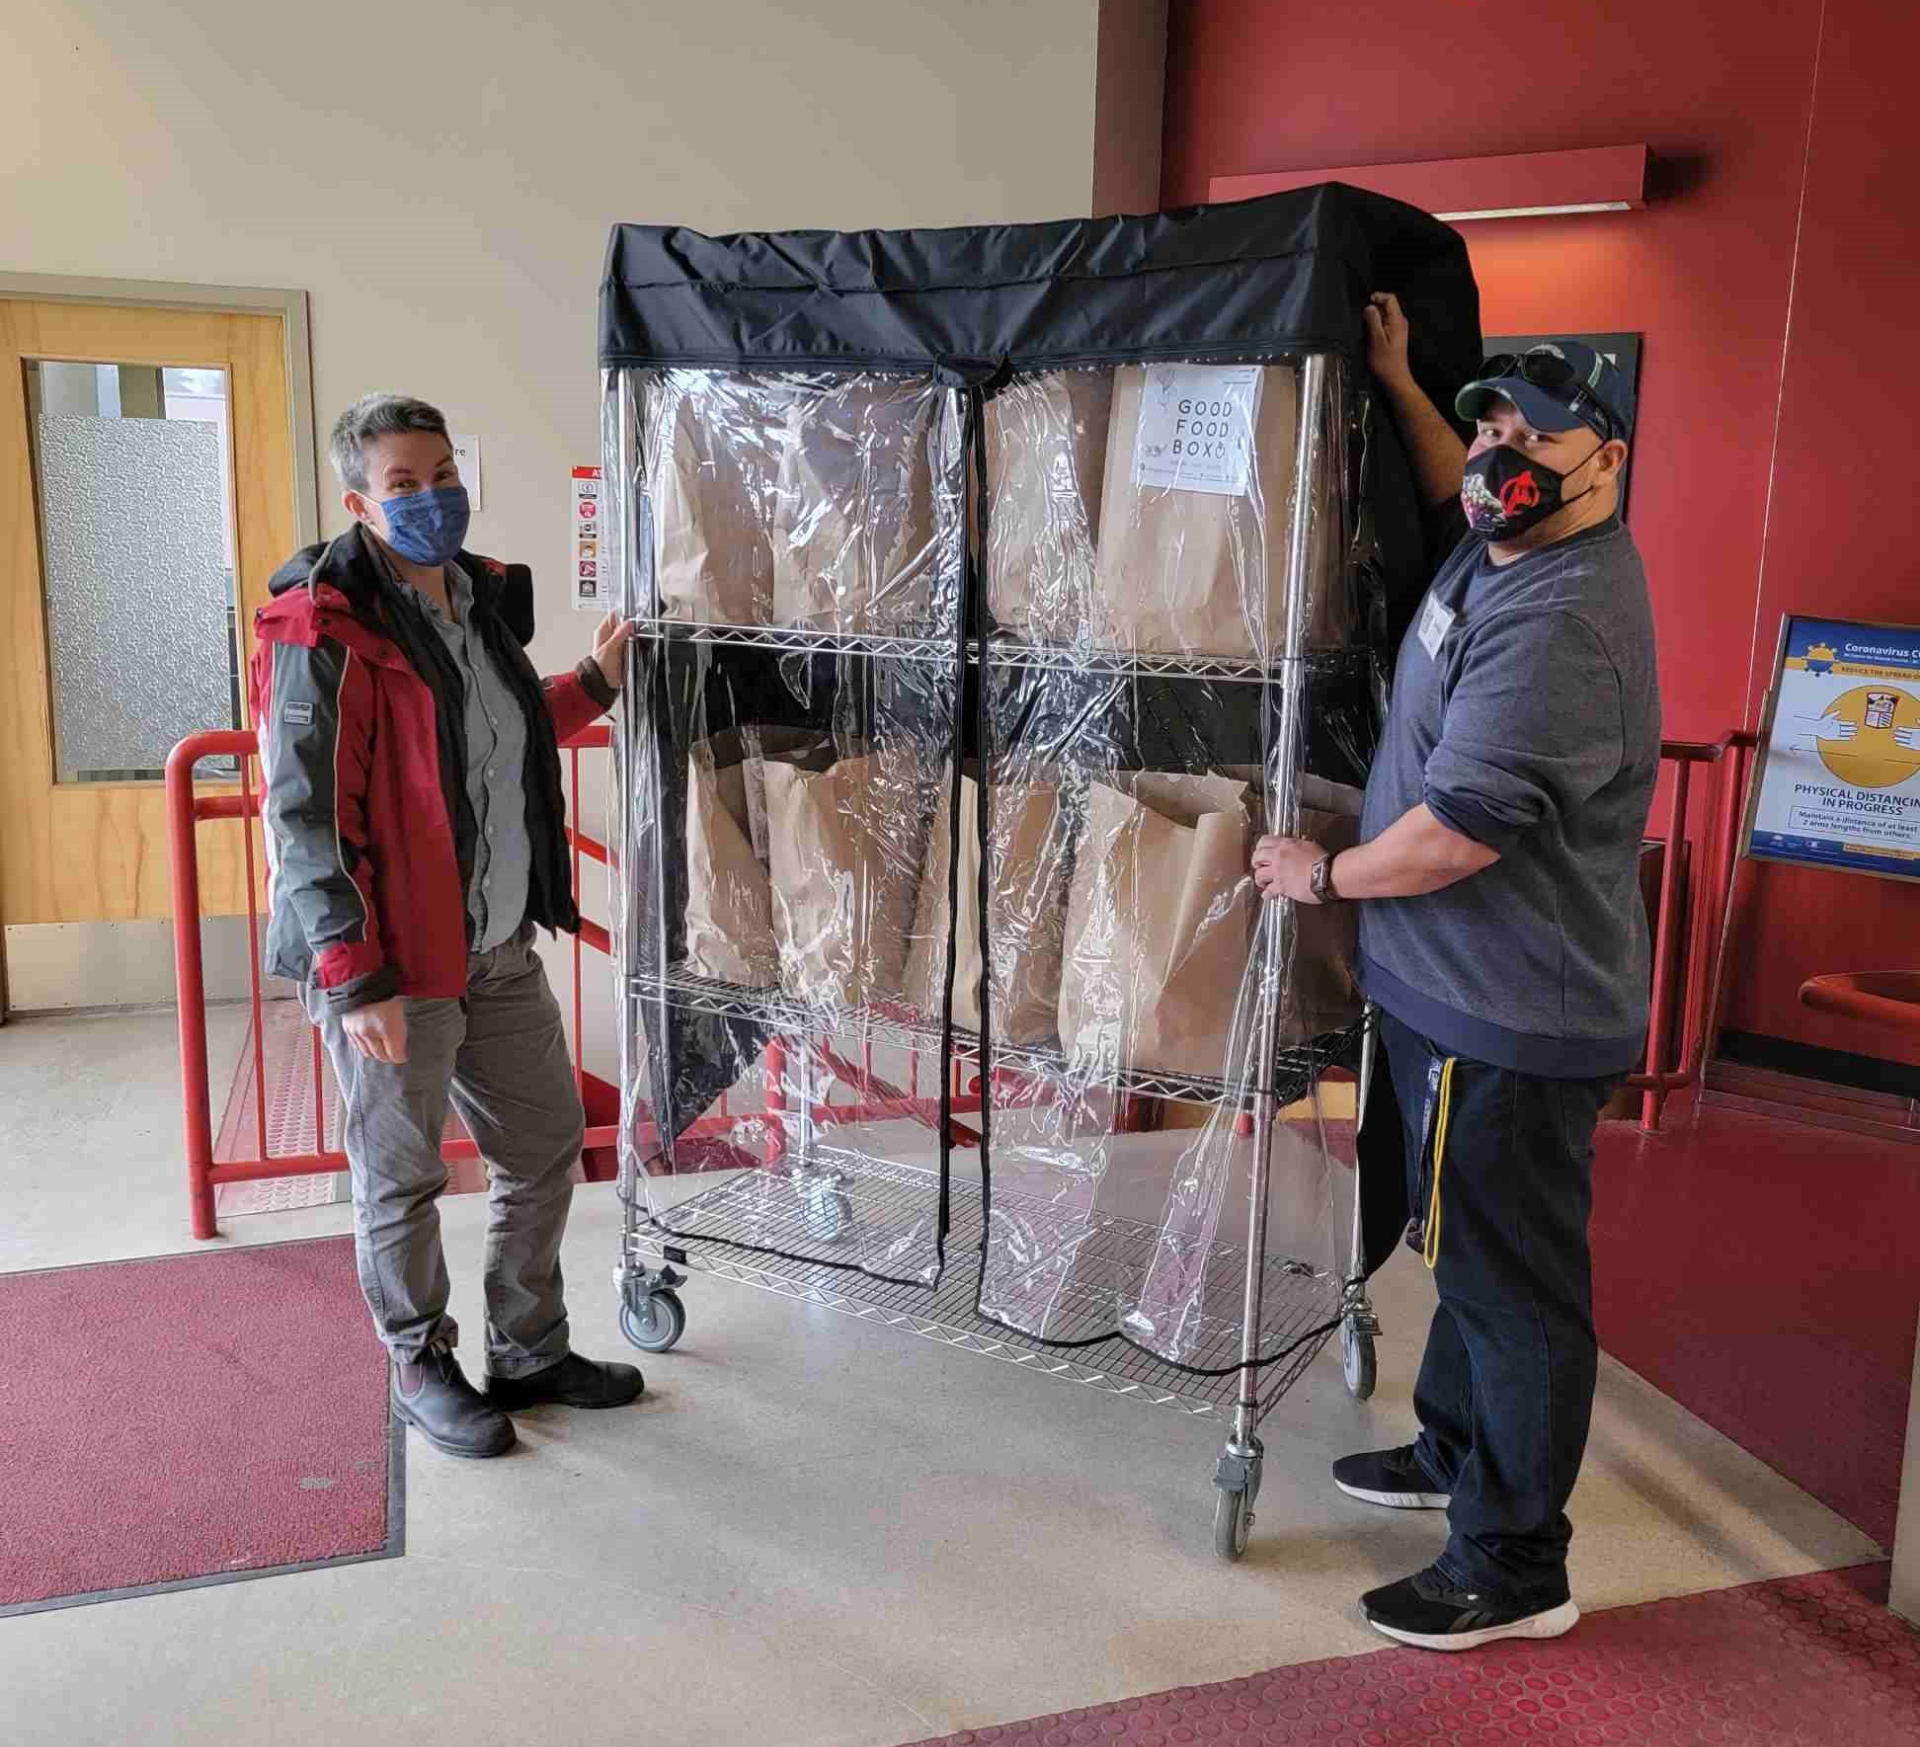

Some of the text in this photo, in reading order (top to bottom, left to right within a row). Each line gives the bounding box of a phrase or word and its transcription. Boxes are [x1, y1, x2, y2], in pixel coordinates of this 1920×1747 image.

[1178, 399, 1232, 417] GOOD
[1175, 419, 1229, 438] FOOD
[1845, 643, 1910, 657] Coronavirus
[1794, 784, 1853, 800] PHYSICAL
[1822, 797, 1903, 816] IN PROGRESS
[1799, 810, 1834, 821] Maintain
[1841, 816, 1876, 827] distance
[1887, 822, 1896, 830] at
[1897, 823, 1918, 832] least
[1809, 820, 1829, 829] arms
[1831, 822, 1861, 832] lengths
[1862, 826, 1882, 835] from
[1883, 829, 1912, 839] others.
